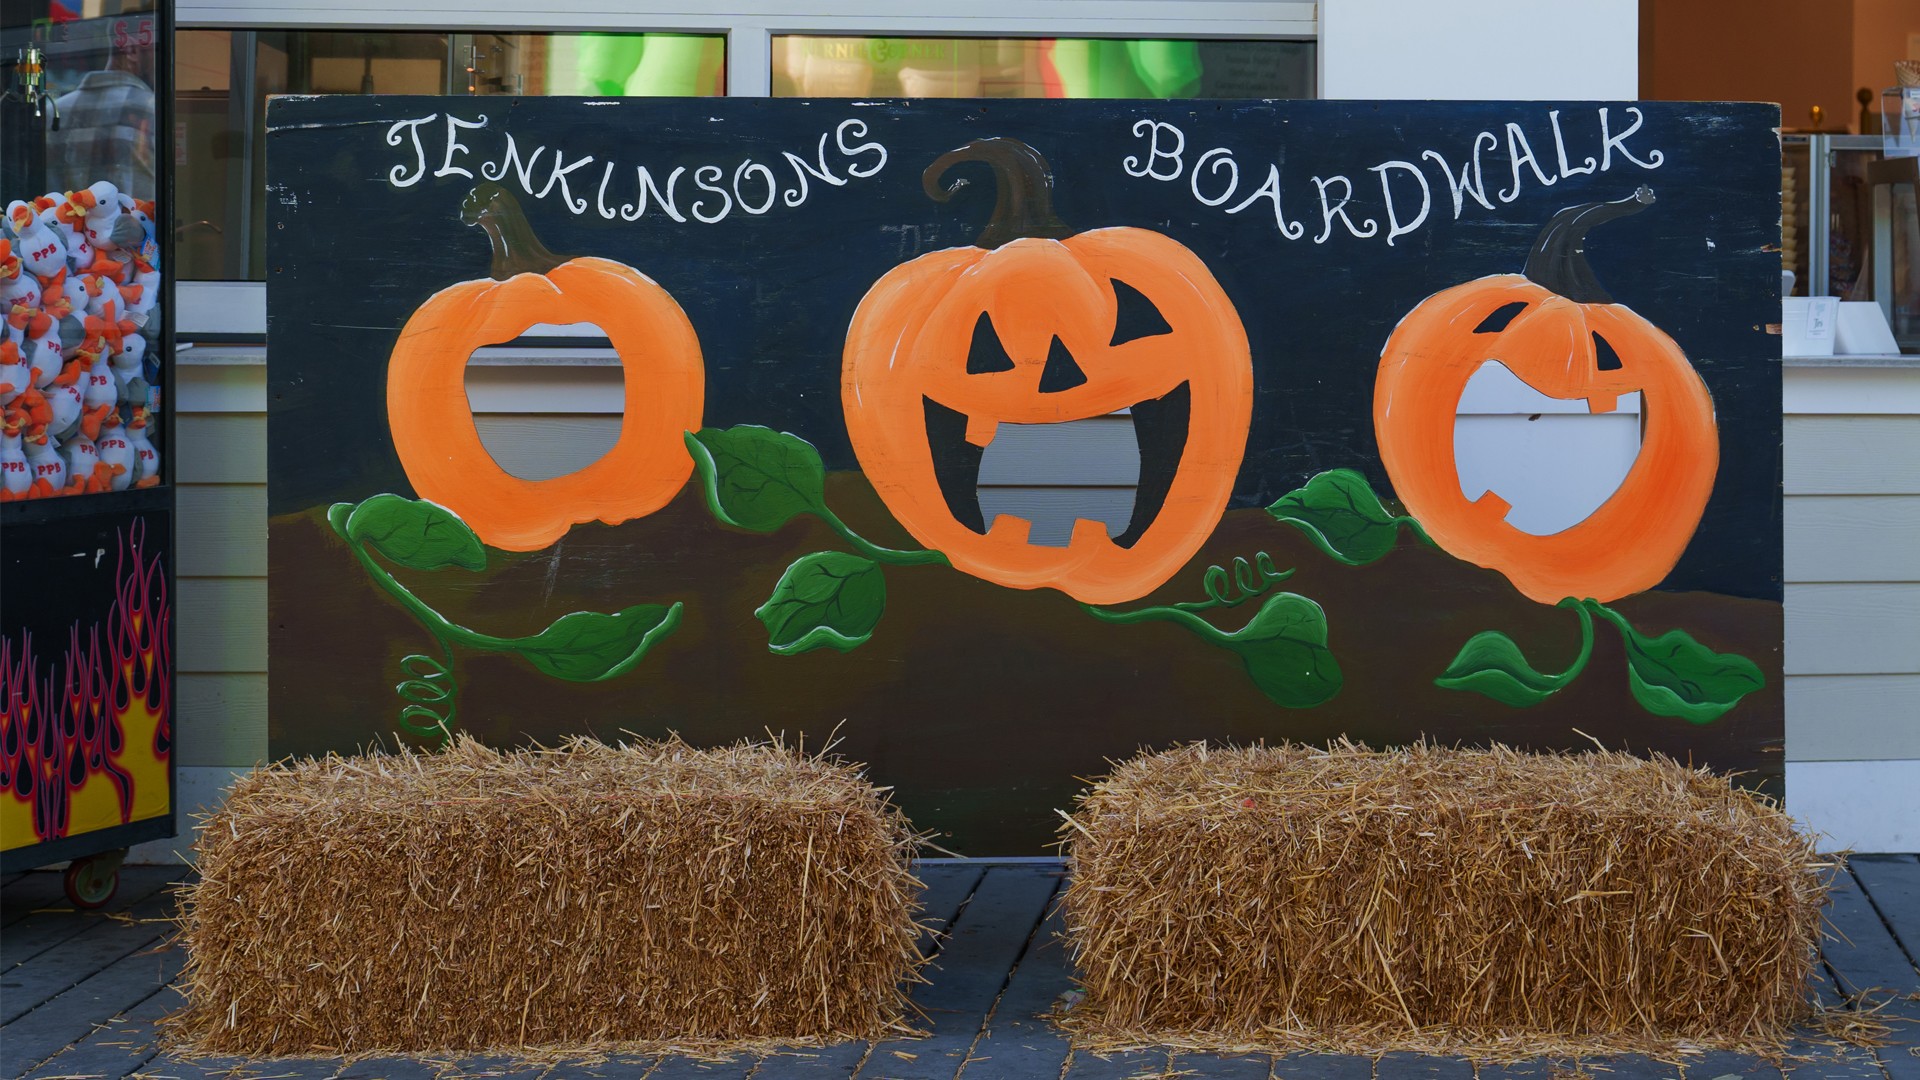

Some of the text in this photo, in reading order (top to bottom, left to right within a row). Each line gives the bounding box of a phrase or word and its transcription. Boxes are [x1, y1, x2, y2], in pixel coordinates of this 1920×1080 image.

[386, 112, 888, 224] JENKINSONS
[1123, 106, 1664, 247] BOARDWALK
[32, 243, 57, 262] PPB
[101, 439, 126, 450] PPB
[1, 461, 25, 473] PPB
[37, 462, 61, 476] PPB
